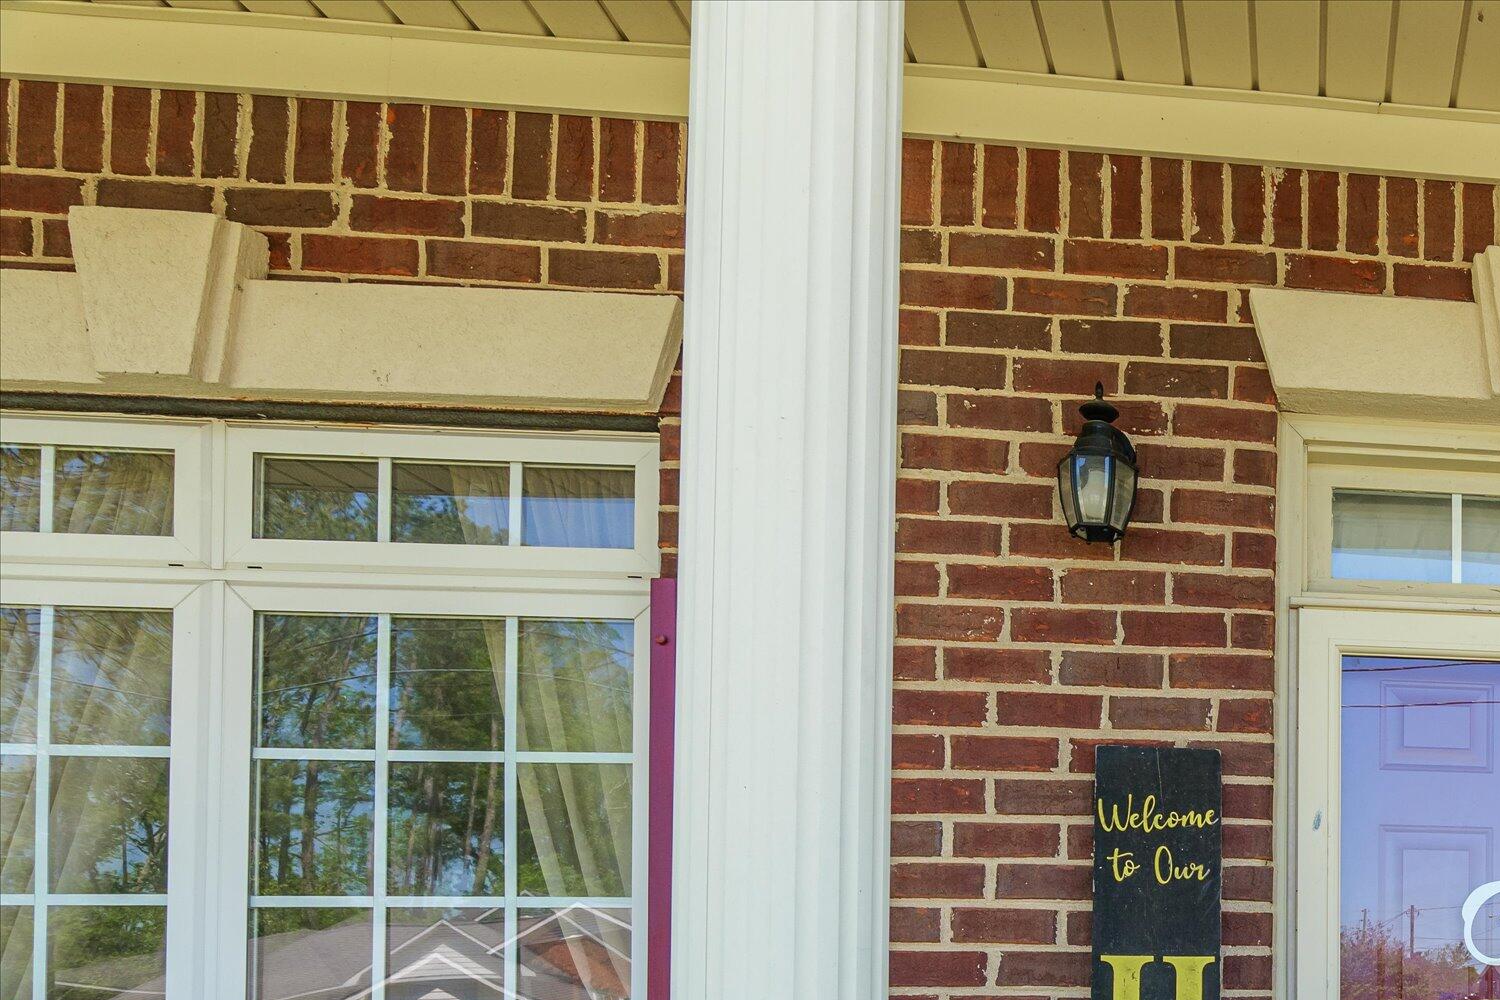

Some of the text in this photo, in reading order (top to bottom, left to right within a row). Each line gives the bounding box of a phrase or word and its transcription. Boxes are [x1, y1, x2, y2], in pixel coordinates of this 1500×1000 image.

[1097, 793, 1219, 833] Welcome
[1106, 845, 1211, 885] to Our
